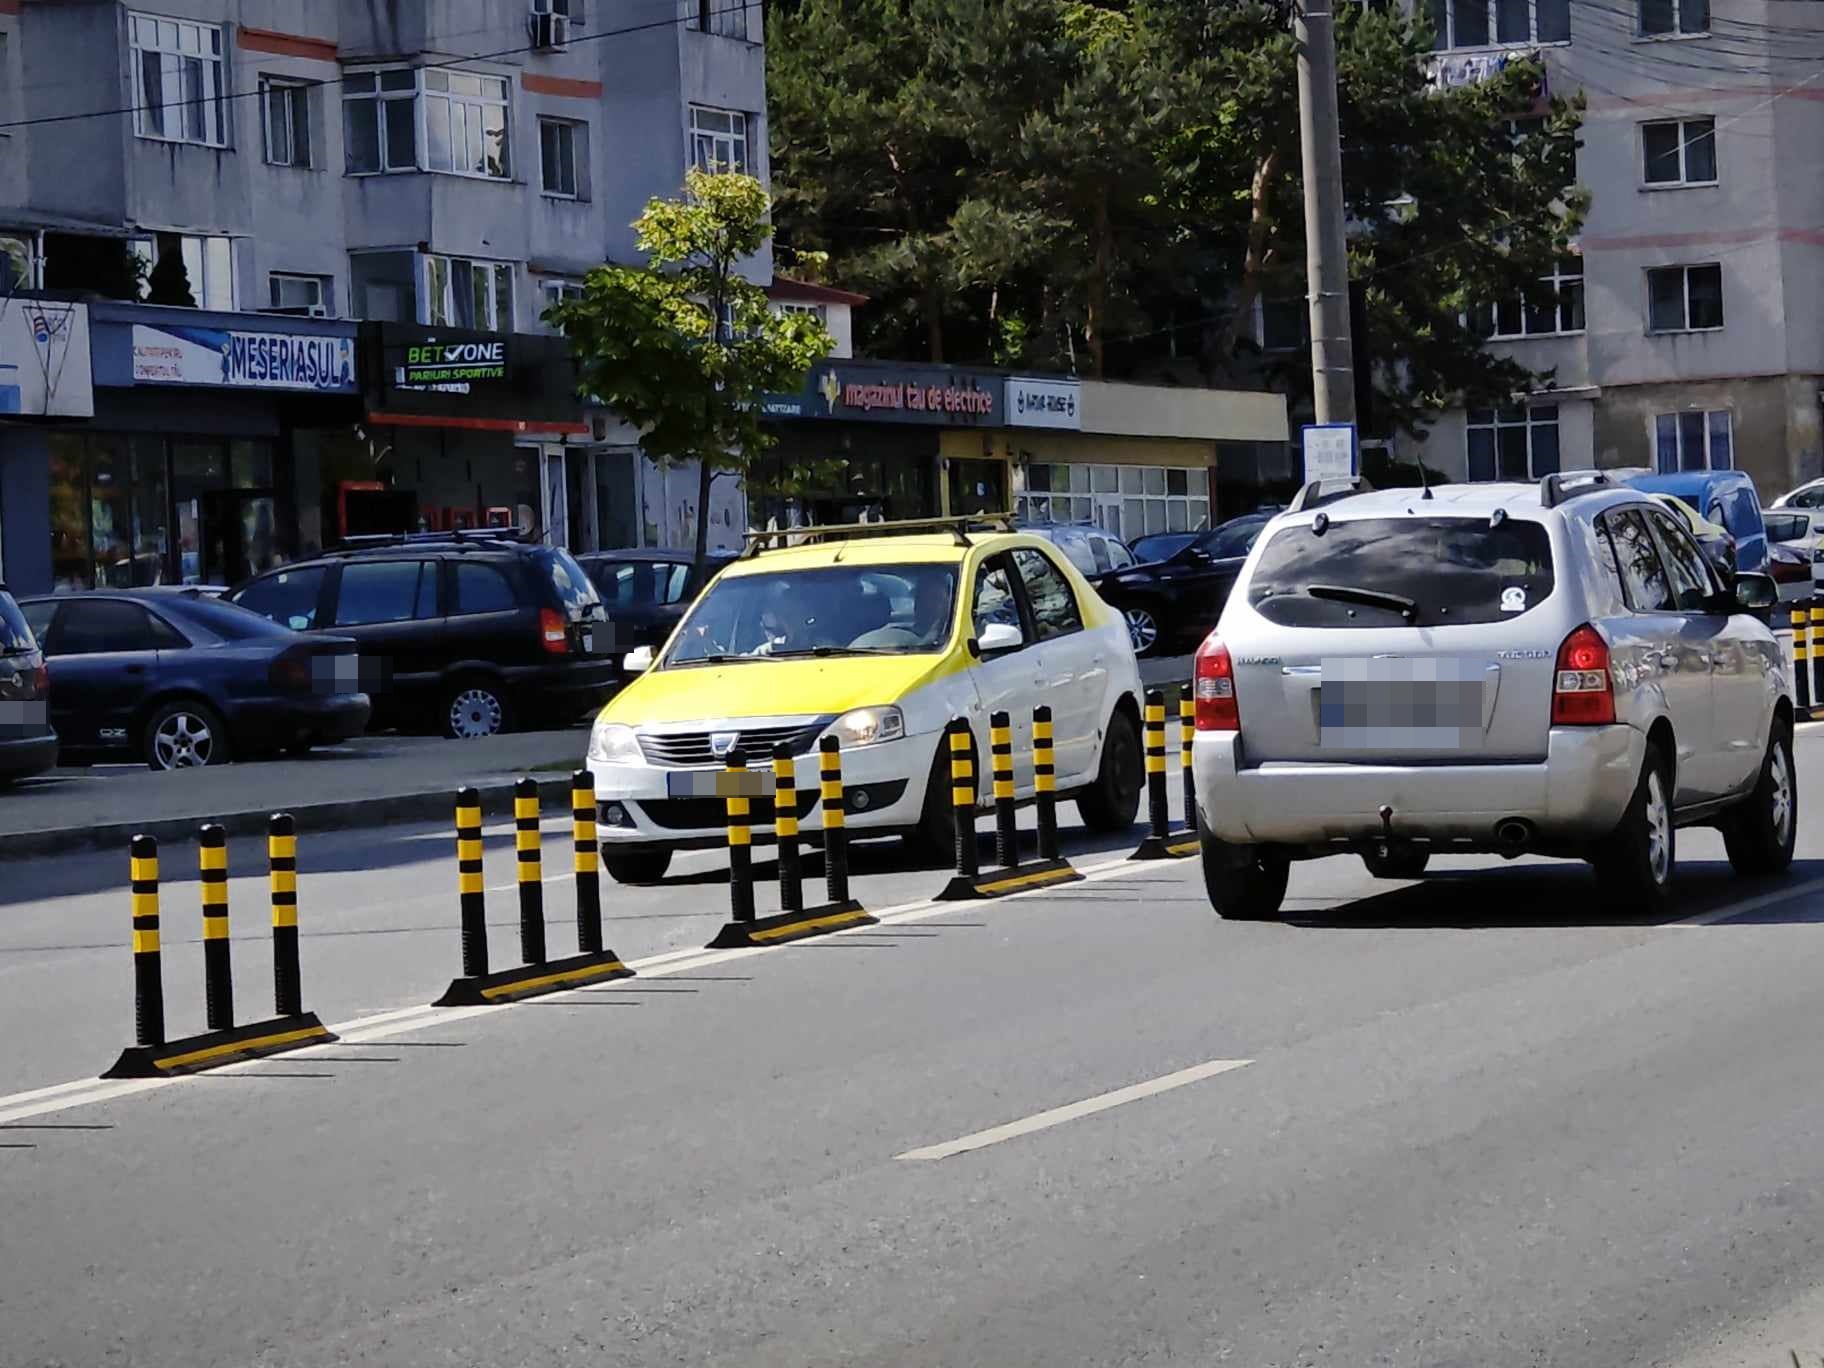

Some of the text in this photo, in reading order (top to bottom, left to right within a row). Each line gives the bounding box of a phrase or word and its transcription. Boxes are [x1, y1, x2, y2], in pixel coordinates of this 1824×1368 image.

[231, 336, 339, 385] MESERIASUL
[408, 346, 444, 363] BET
[452, 367, 504, 380] SPORTIVE
[844, 383, 904, 410] magazinul
[929, 386, 942, 410] de
[945, 387, 992, 414] electrice
